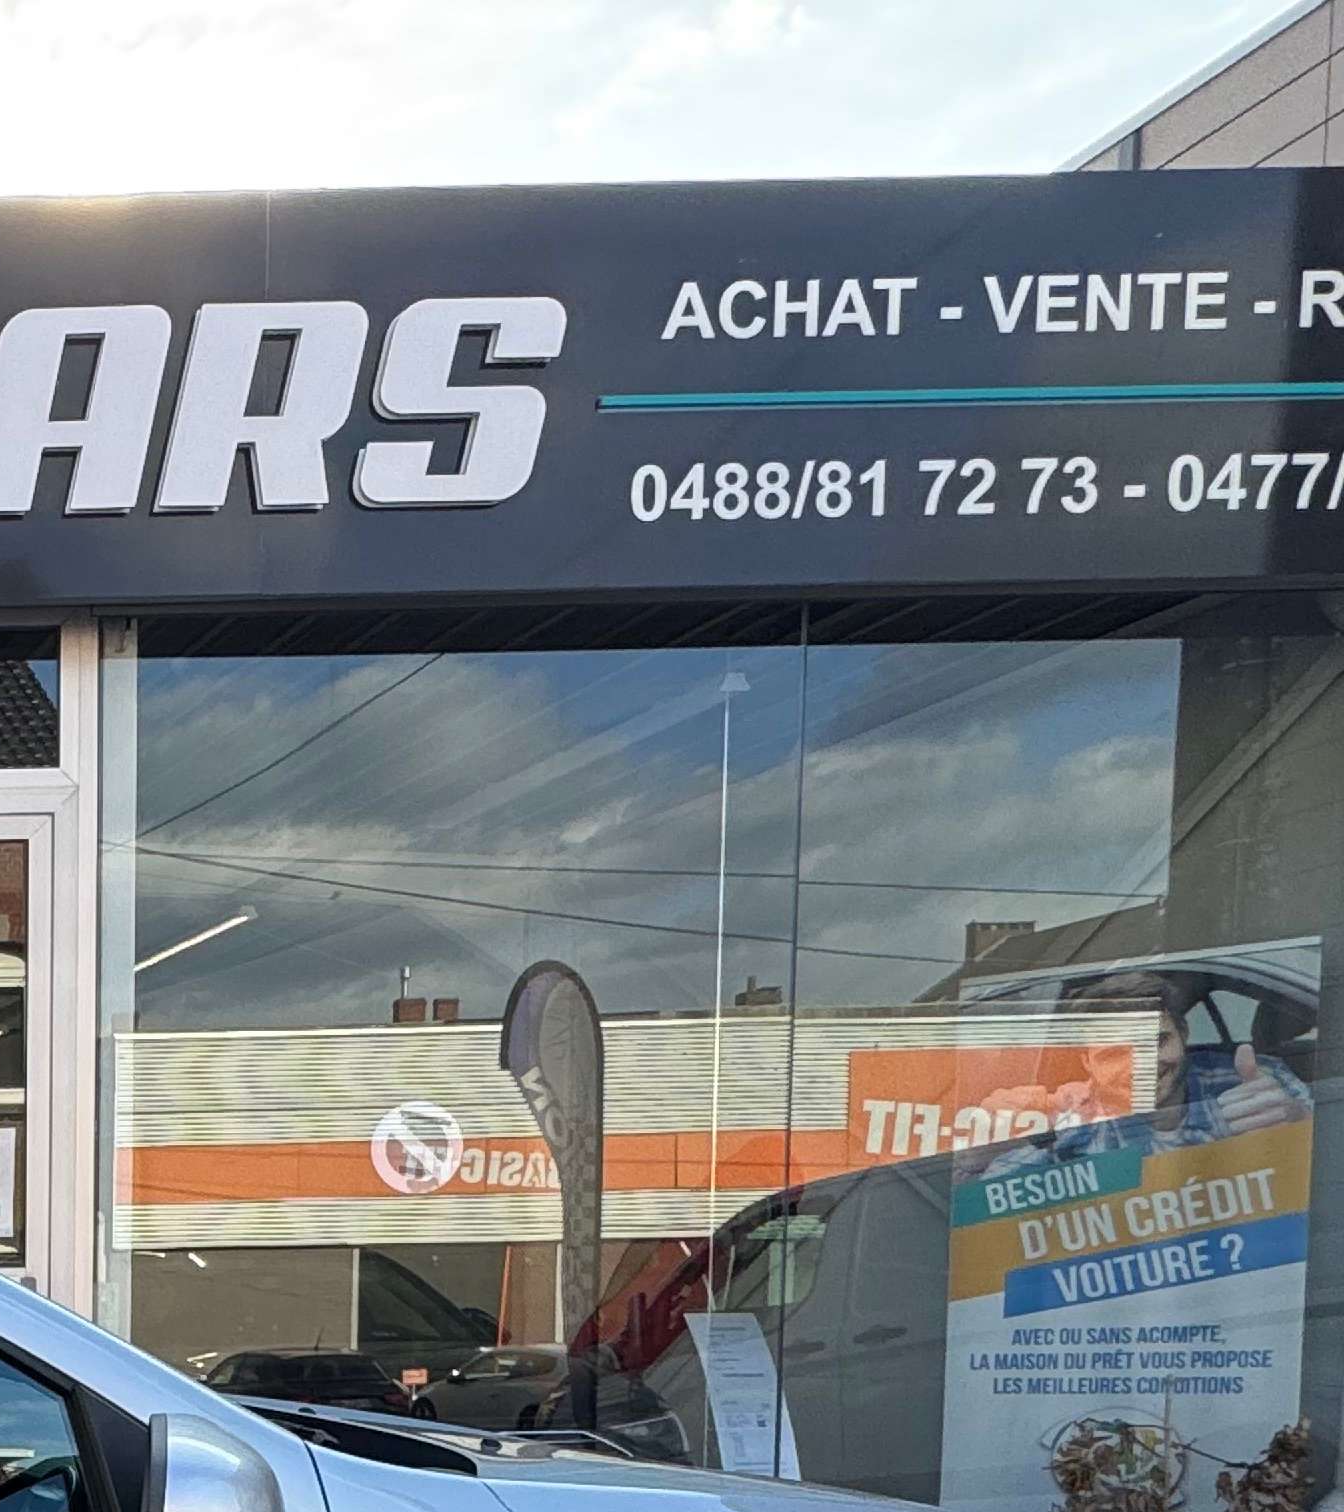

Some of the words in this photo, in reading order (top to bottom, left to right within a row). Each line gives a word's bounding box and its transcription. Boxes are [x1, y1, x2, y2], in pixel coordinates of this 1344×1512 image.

[661, 277, 918, 340] ACHAT
[983, 271, 1230, 335] VENTE
[629, 458, 888, 523] 0488/81
[918, 457, 997, 518] 72
[1020, 455, 1100, 516] 73
[984, 1160, 1100, 1216] BESOIN
[1018, 1203, 1118, 1261] D'UN
[1123, 1167, 1276, 1238] CRÉDIT
[1052, 1239, 1215, 1303] VOITURE
[1220, 1232, 1245, 1271] ?
[969, 1353, 990, 1371] LA
[994, 1352, 1059, 1370] MAISON
[1064, 1352, 1085, 1370] DU
[1091, 1348, 1135, 1370] PRÊT
[1140, 1351, 1186, 1369] VOUS
[1190, 1350, 1274, 1369] PROPOSE
[1011, 1328, 1055, 1346] AVEC
[1061, 1327, 1082, 1345] OU
[1087, 1326, 1132, 1345] SANS
[1136, 1324, 1227, 1346] ACOMPTE,
[993, 1377, 1023, 1395] LES
[1027, 1376, 1132, 1395] MEILLEURES
